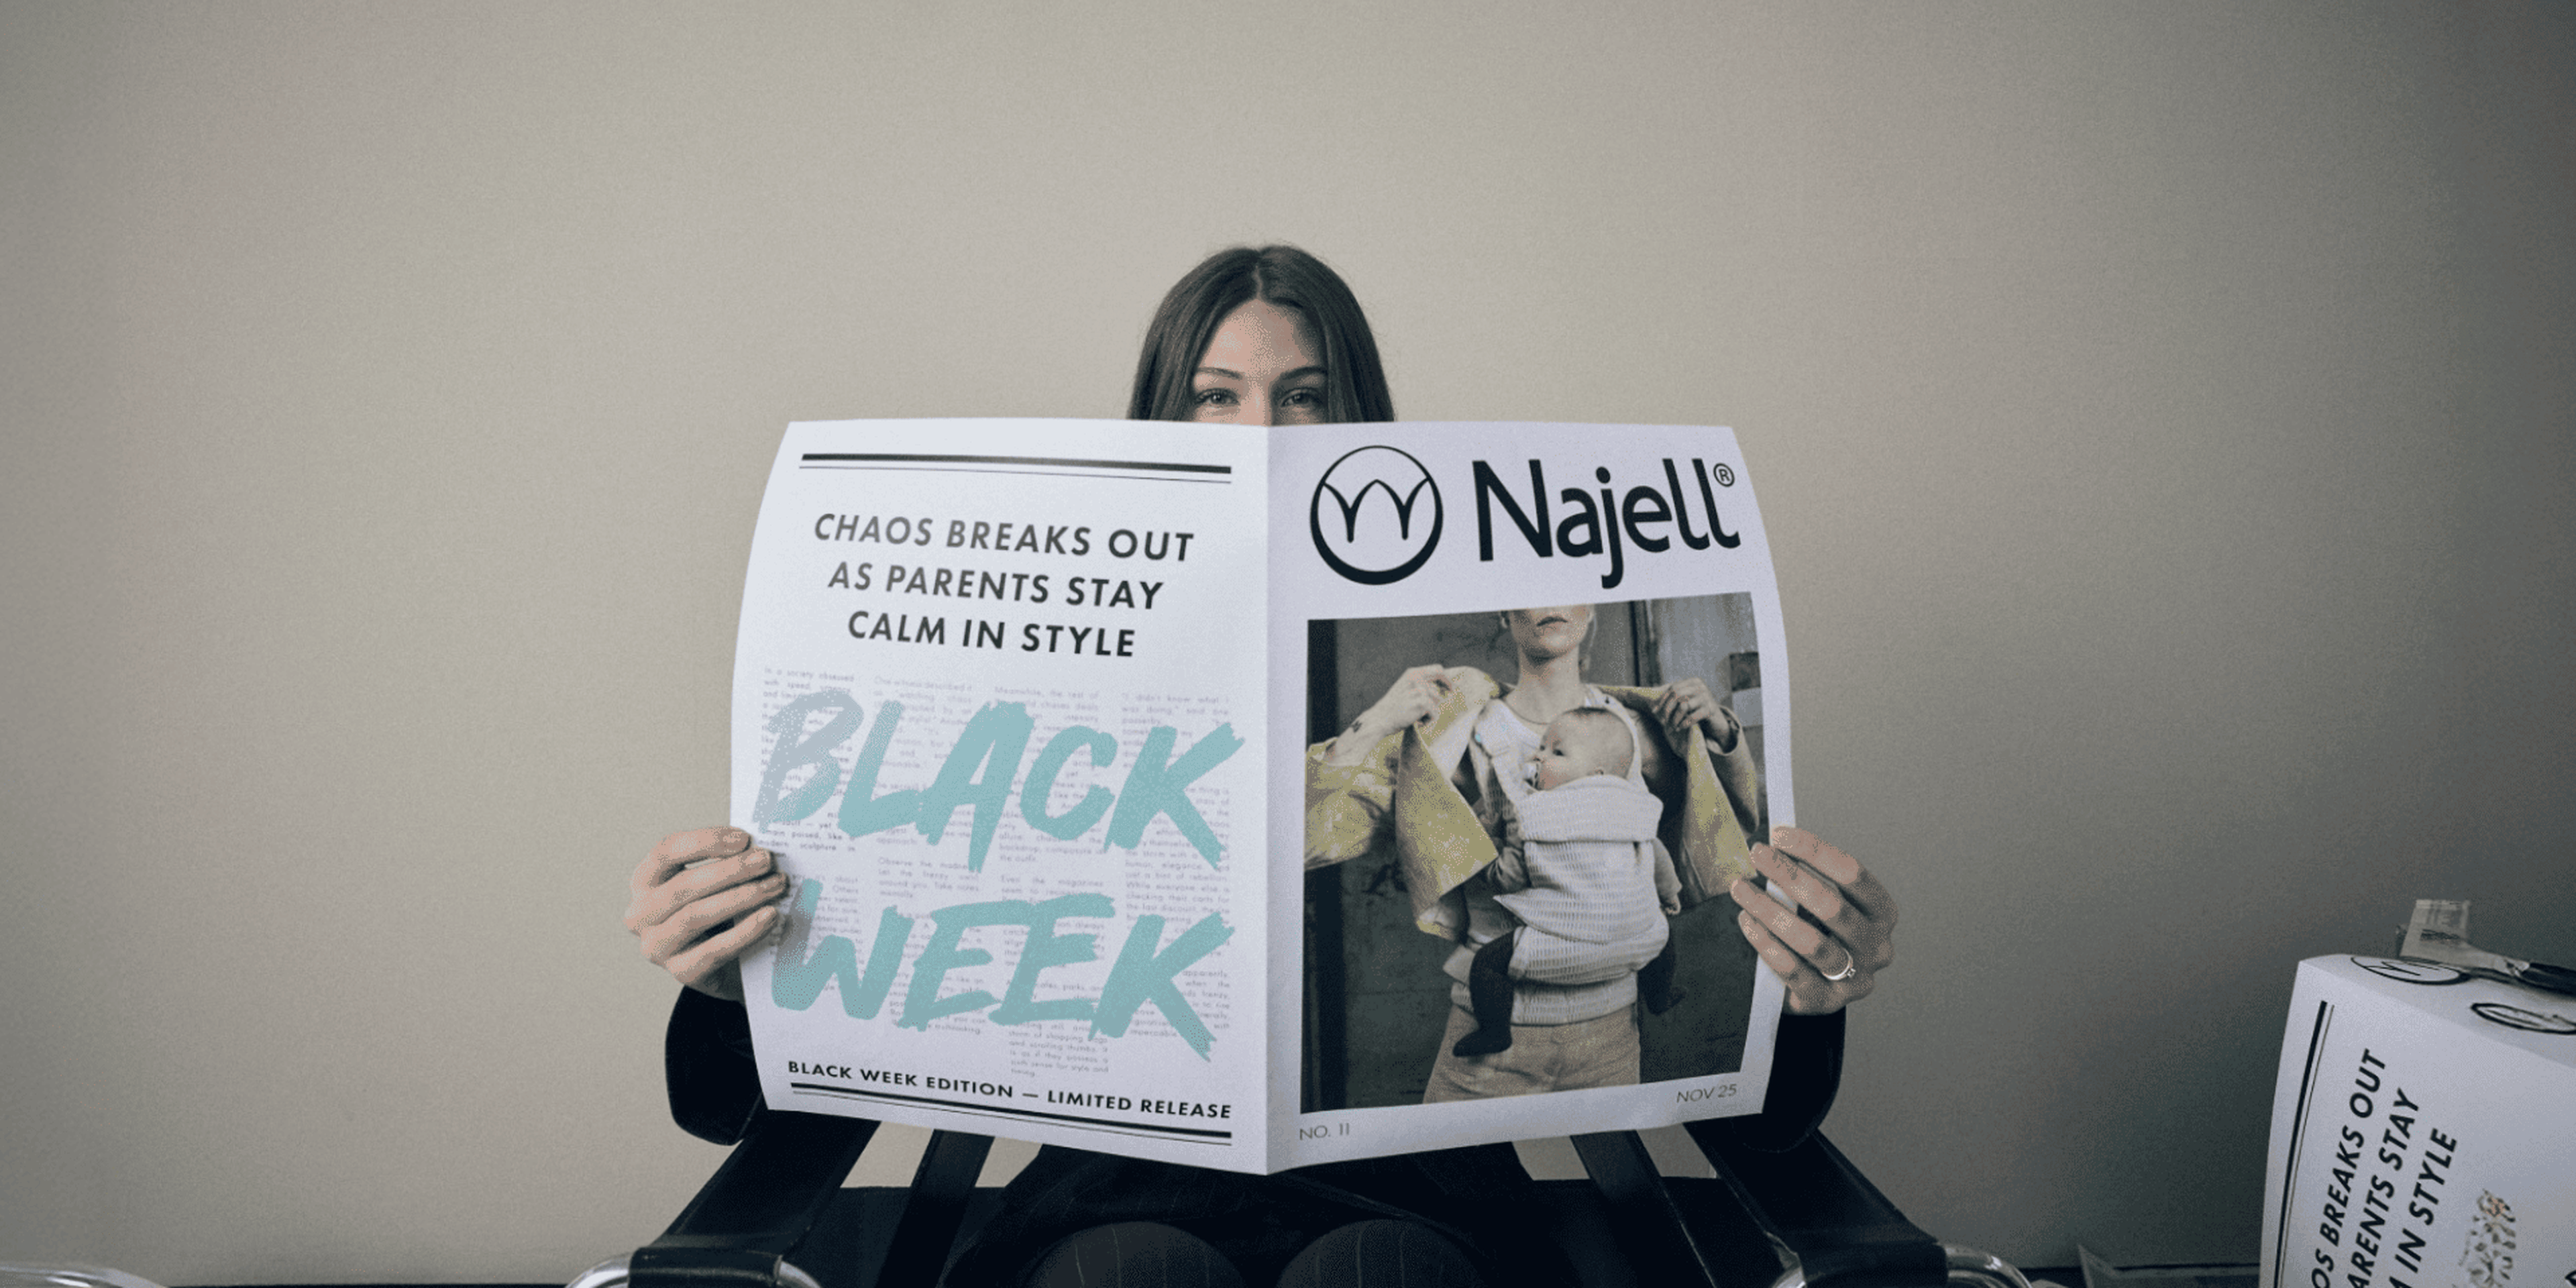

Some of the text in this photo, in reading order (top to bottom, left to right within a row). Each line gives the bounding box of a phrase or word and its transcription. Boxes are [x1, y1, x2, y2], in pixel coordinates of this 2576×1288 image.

[814, 513, 1195, 562] CHAOS BREAKS OUT
[827, 561, 1164, 610] AS PARENTS STAY
[848, 610, 1136, 658] CALM IN STYLE
[752, 690, 1244, 873] BLACK
[771, 879, 1235, 1062] WEEK
[788, 1061, 852, 1079] BLACK
[859, 1069, 917, 1087] WEEK
[926, 1077, 1014, 1098] EDITION
[1048, 1090, 1132, 1110] LIMITED
[1140, 1099, 1232, 1120] RELEASE
[1299, 1124, 1331, 1140] NO.
[2319, 1125, 2365, 1247] BREAKS
[2349, 1049, 2386, 1118] OUT
[2378, 1087, 2420, 1171] STAY
[2408, 1128, 2457, 1226] STYLE
[2394, 1228, 2426, 1274] IN
